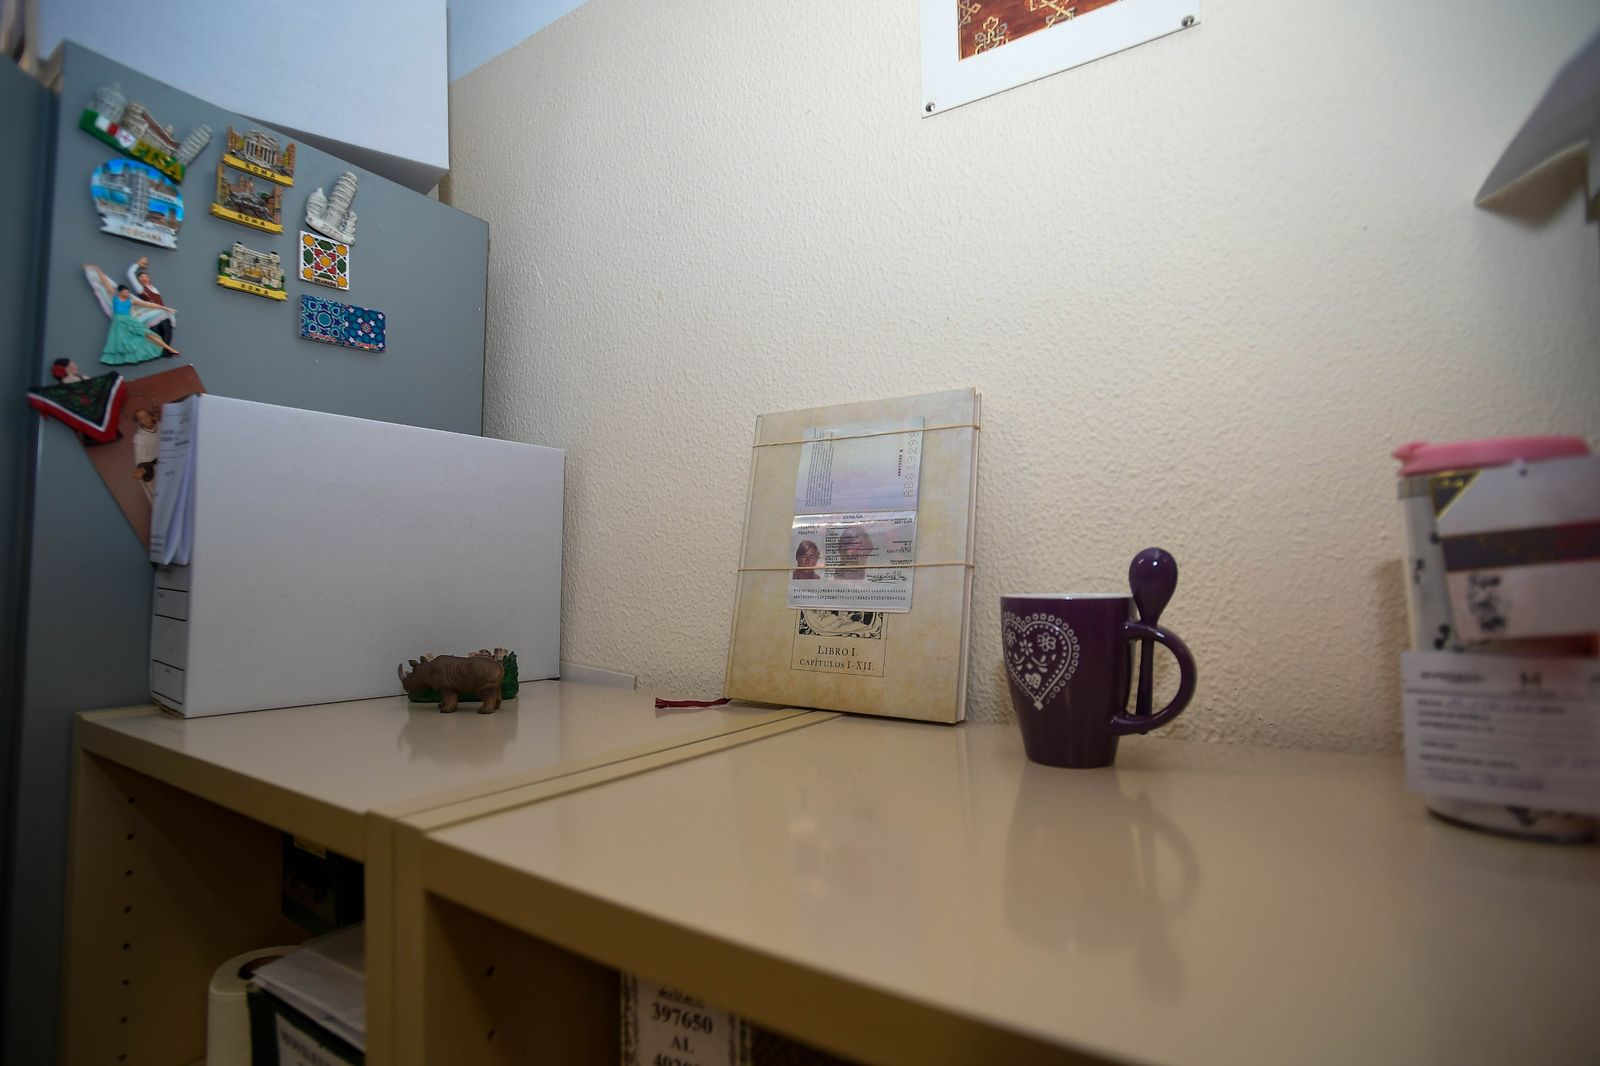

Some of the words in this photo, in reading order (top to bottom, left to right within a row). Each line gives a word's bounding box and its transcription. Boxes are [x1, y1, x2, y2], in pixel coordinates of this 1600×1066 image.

[130, 139, 183, 182] PISA
[245, 162, 275, 178] ROMA
[238, 213, 266, 228] ROMA
[240, 283, 270, 295] ROMA
[817, 645, 849, 657] LIBRO
[799, 658, 845, 669] CAPÍTULOS
[651, 1003, 713, 1034] 397650
[670, 1036, 695, 1055] AL
